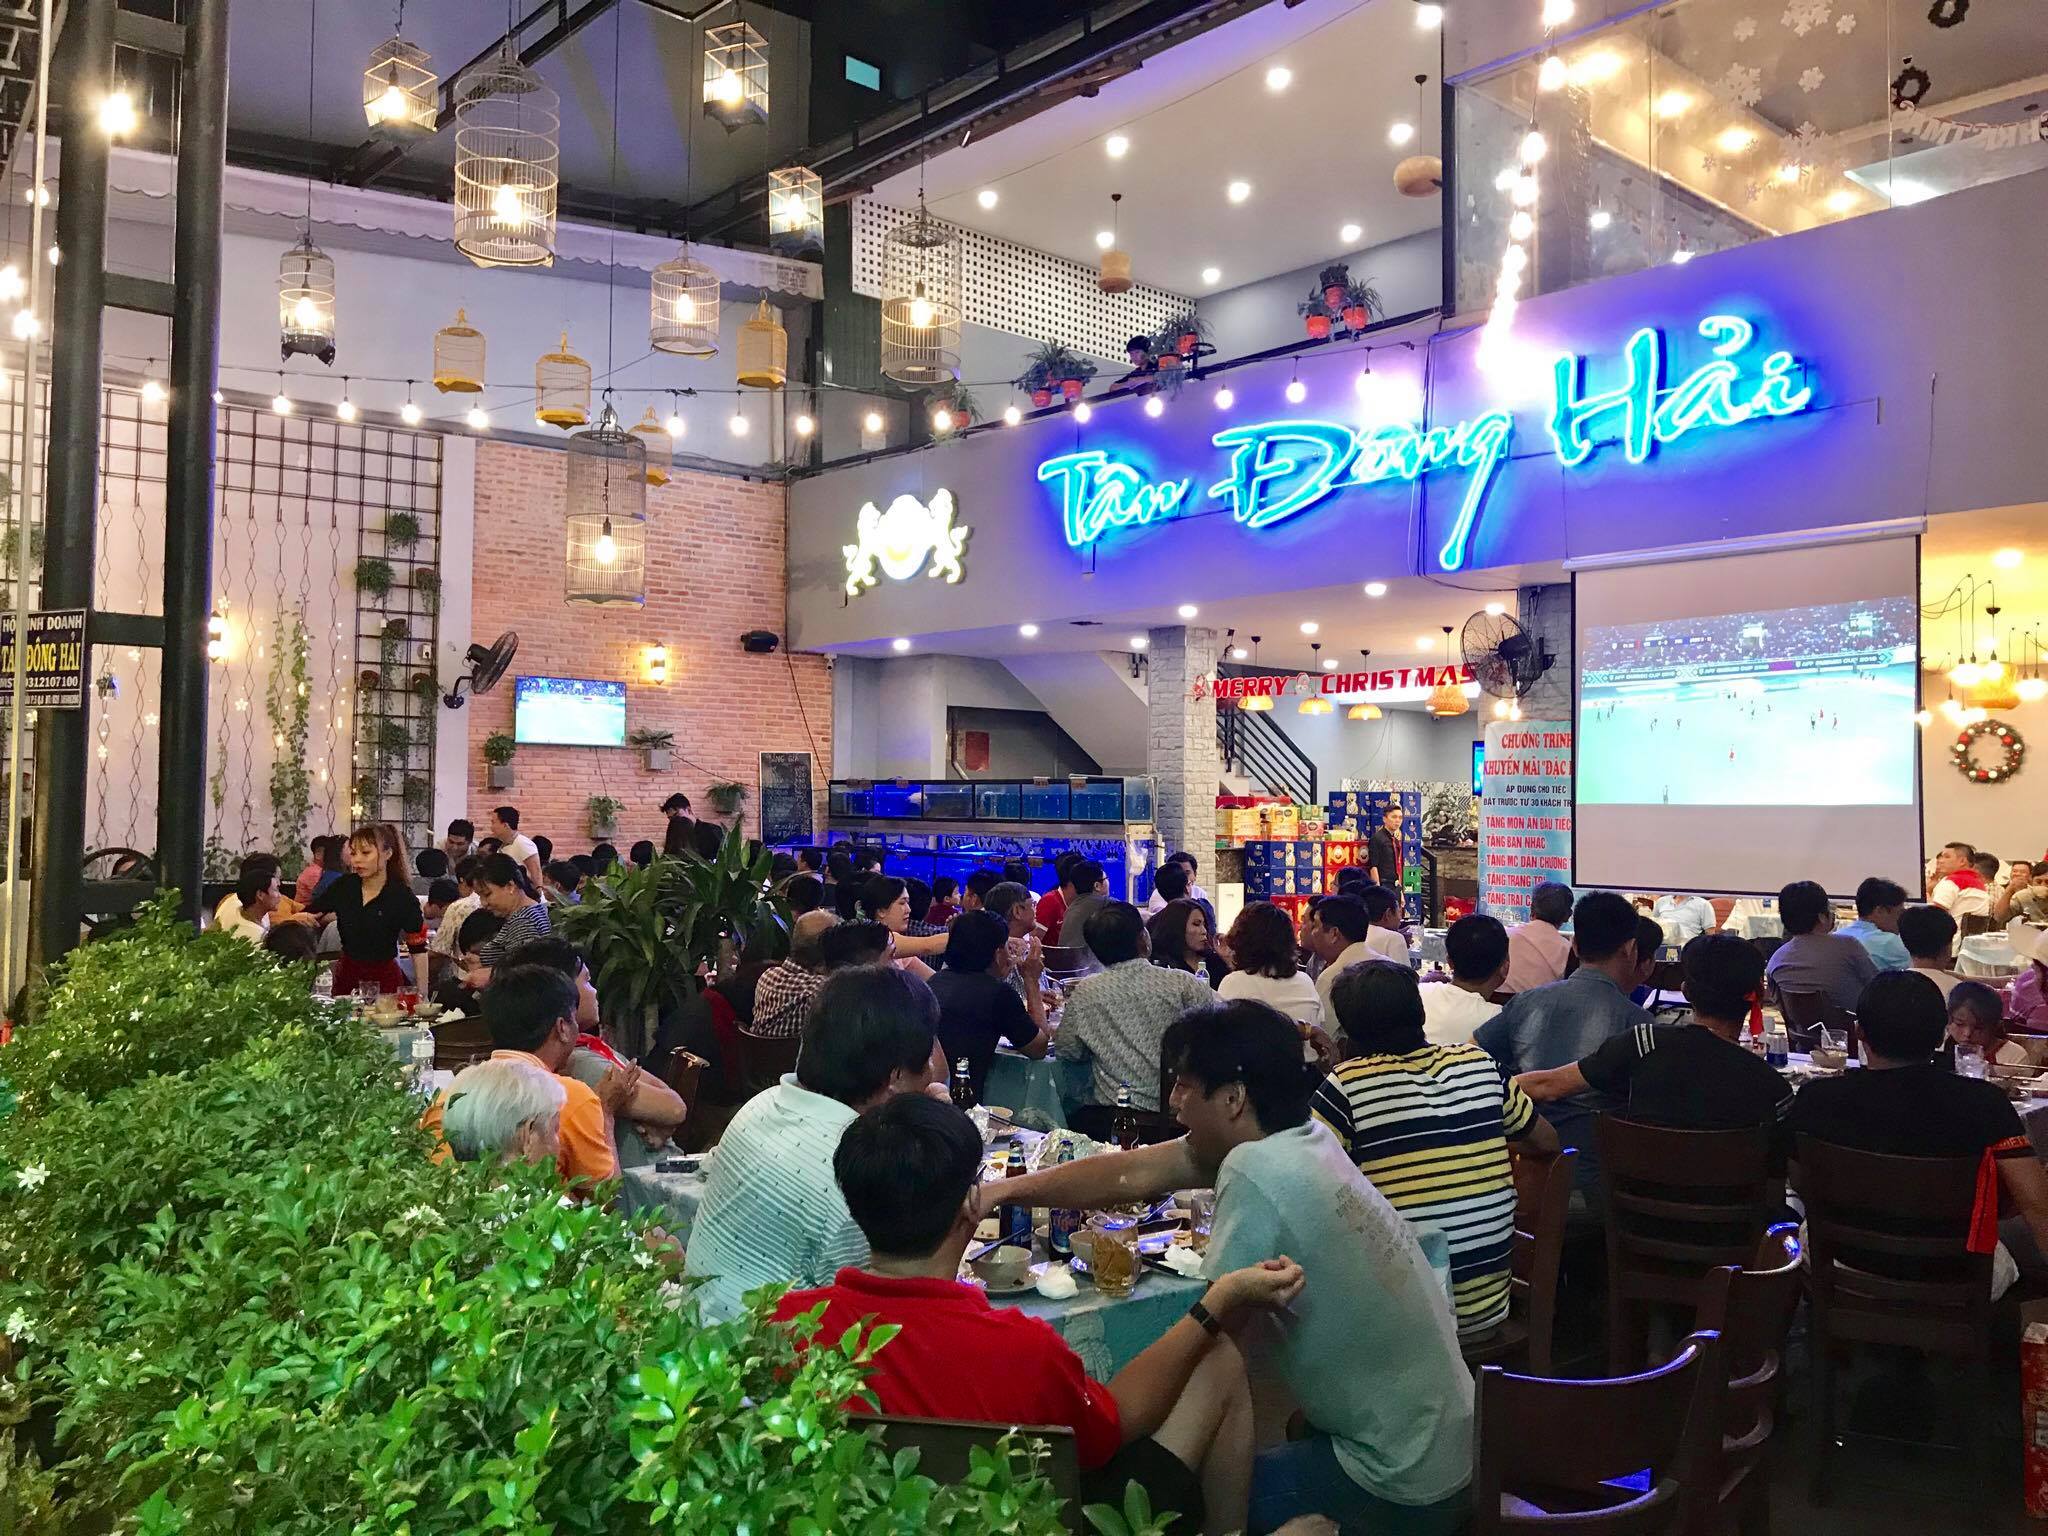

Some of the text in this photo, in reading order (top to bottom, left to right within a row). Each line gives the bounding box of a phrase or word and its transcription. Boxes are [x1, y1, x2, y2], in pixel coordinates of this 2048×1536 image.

[1038, 450, 1188, 546] Tân
[1545, 314, 1812, 467] Hải
[46, 615, 82, 630] DOANH
[1, 637, 16, 673] TÂ
[59, 631, 81, 671] HẢI
[1213, 661, 1479, 698] MERRY CHRISTMAS
[1501, 731, 1540, 749] CHƯƠNG
[1507, 855, 1519, 867] MC
[1507, 874, 1531, 887] TRANG
